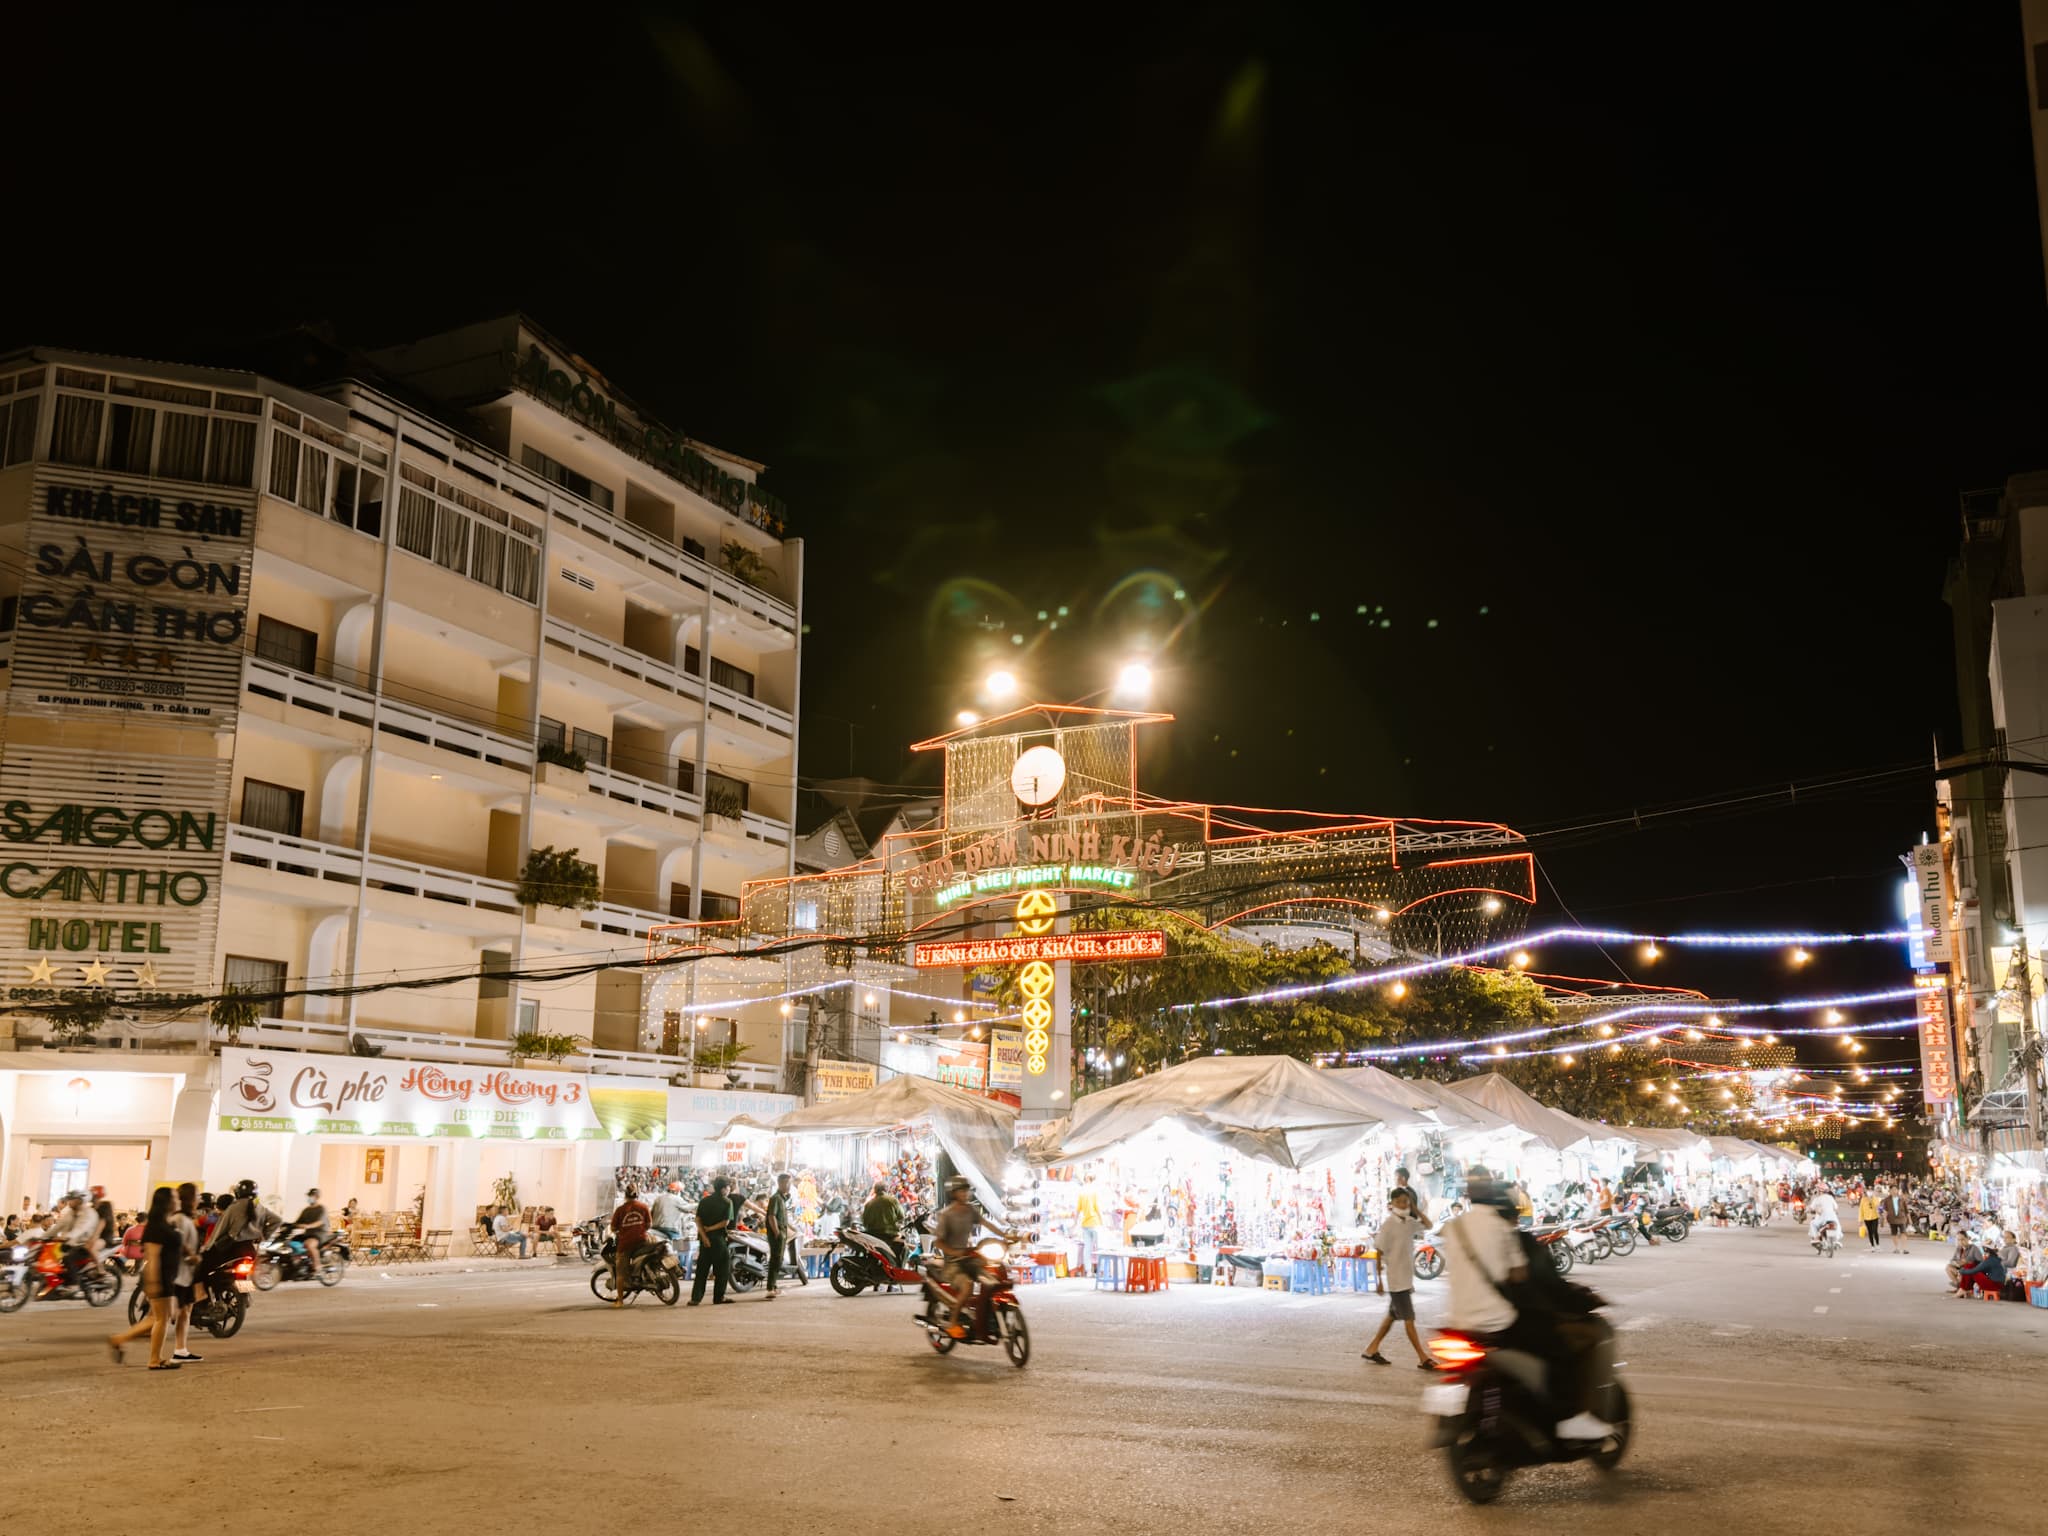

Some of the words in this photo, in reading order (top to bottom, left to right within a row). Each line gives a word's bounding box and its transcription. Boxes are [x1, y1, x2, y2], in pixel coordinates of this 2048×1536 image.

[175, 501, 243, 542] SẠN
[35, 535, 114, 583] SÀI
[126, 546, 241, 596] GÒN
[22, 585, 138, 634] CẦN
[151, 606, 244, 644] THƠ
[0, 800, 216, 850] SAIGON
[1031, 832, 1101, 863] NINH
[0, 862, 208, 906] CANTHO
[1016, 866, 1063, 885] NIGHT
[1069, 866, 1135, 888] MARKET
[28, 918, 170, 954] HOTEL
[1042, 936, 1097, 956] KHÁCH
[290, 1066, 333, 1115] Cà
[336, 1071, 387, 1111] phê
[400, 1065, 472, 1102] Hồng
[479, 1071, 558, 1106] Hương
[563, 1082, 581, 1103] 3
